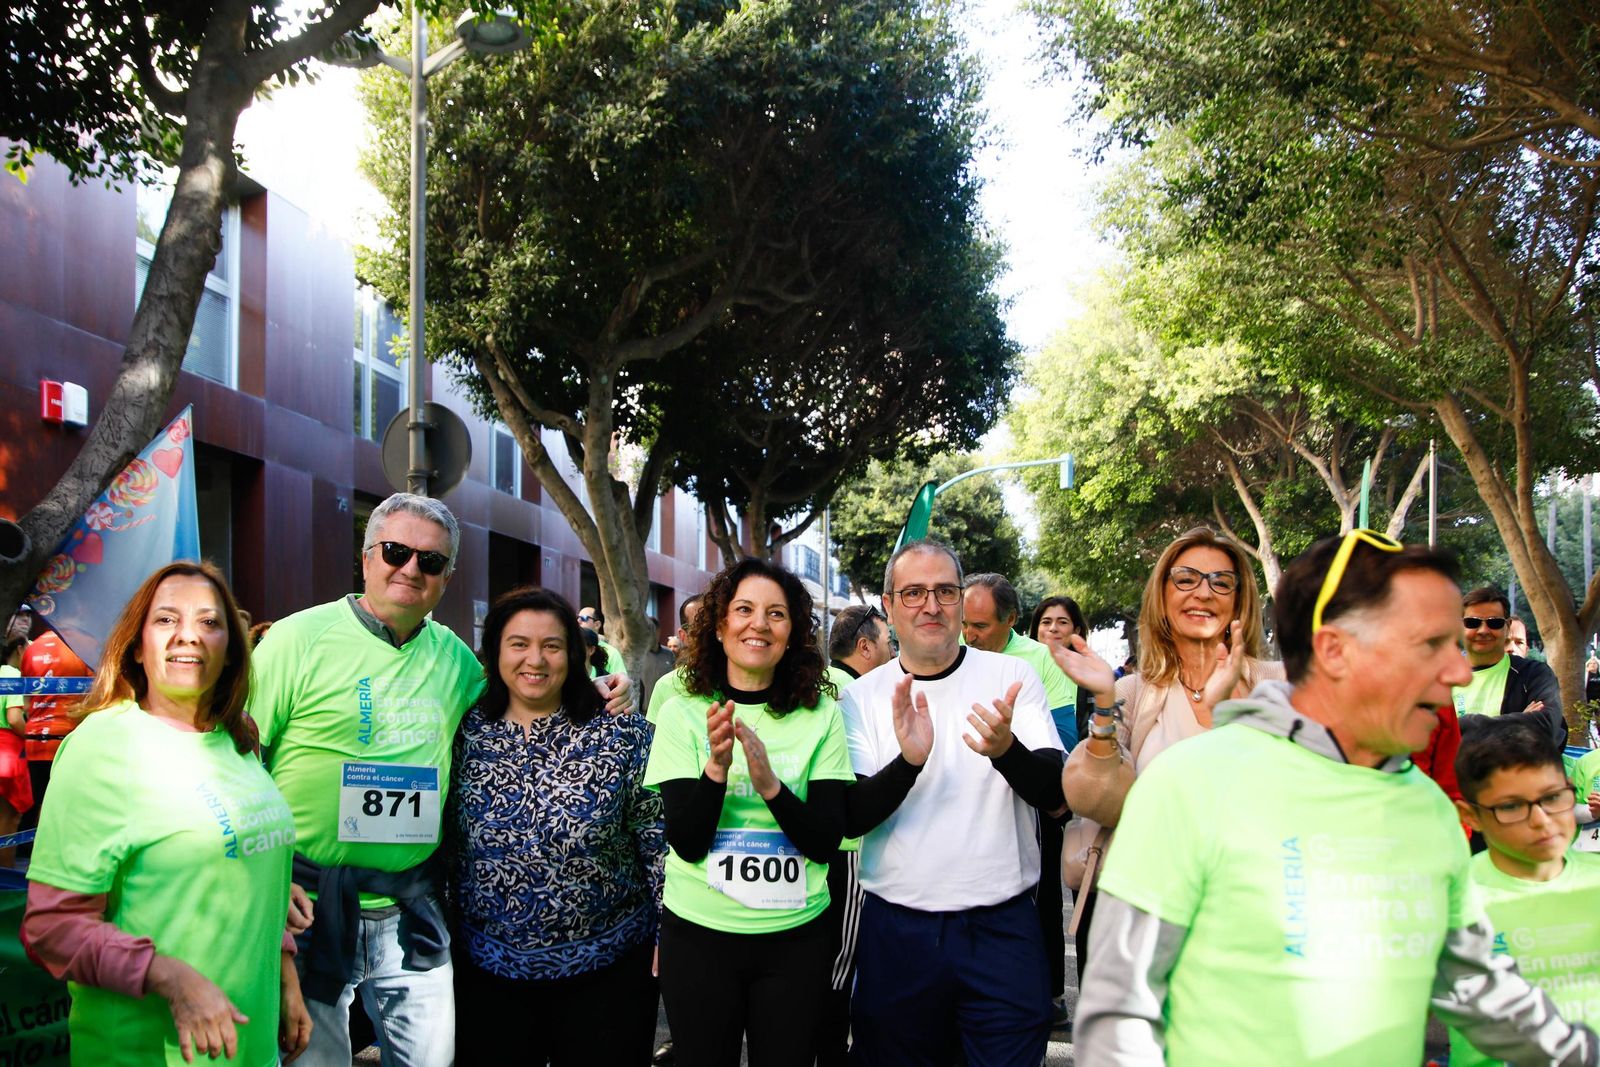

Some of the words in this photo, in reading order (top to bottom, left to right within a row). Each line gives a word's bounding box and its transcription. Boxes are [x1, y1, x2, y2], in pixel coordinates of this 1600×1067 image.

[356, 676, 373, 745] ALMERÍA
[347, 773, 371, 781] contra
[362, 789, 421, 817] 871
[242, 826, 296, 856] cánc
[718, 855, 800, 883] 1600
[1551, 950, 1600, 970] marc
[18, 993, 72, 1031] cán
